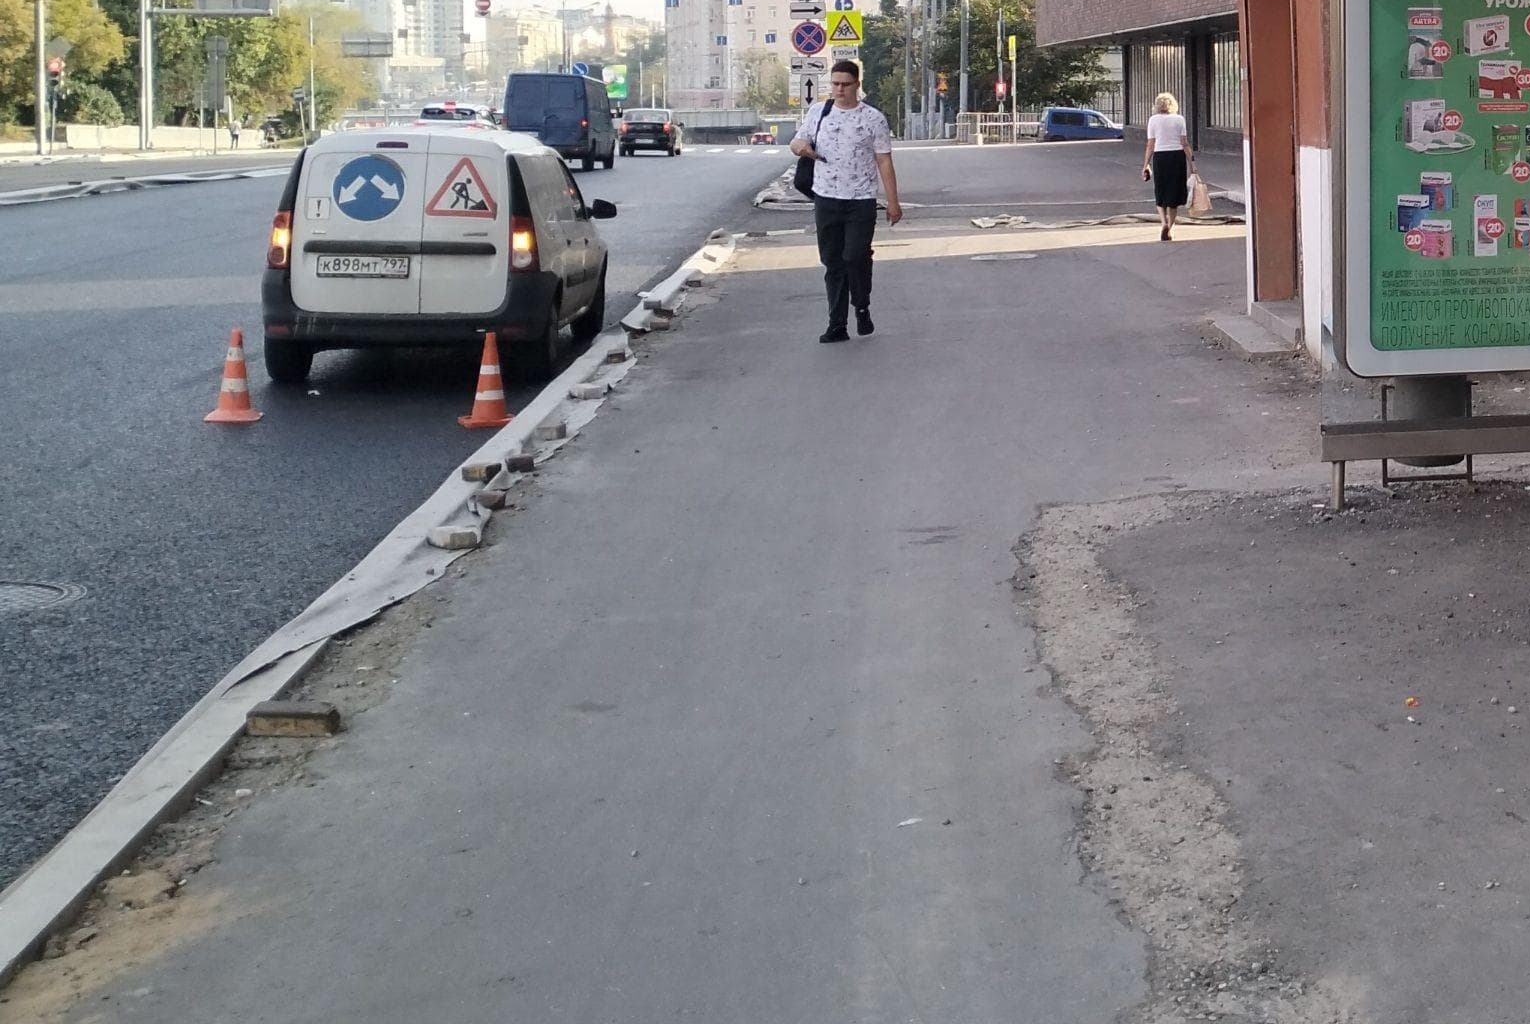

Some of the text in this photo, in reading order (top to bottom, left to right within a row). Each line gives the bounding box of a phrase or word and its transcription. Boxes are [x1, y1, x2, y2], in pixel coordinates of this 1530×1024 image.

[322, 258, 405, 272] К898МТ 797
[1382, 299, 1441, 321] ИМЕЮТСЯ
[1382, 324, 1456, 347] ПОЛУЧЕНИЕ
